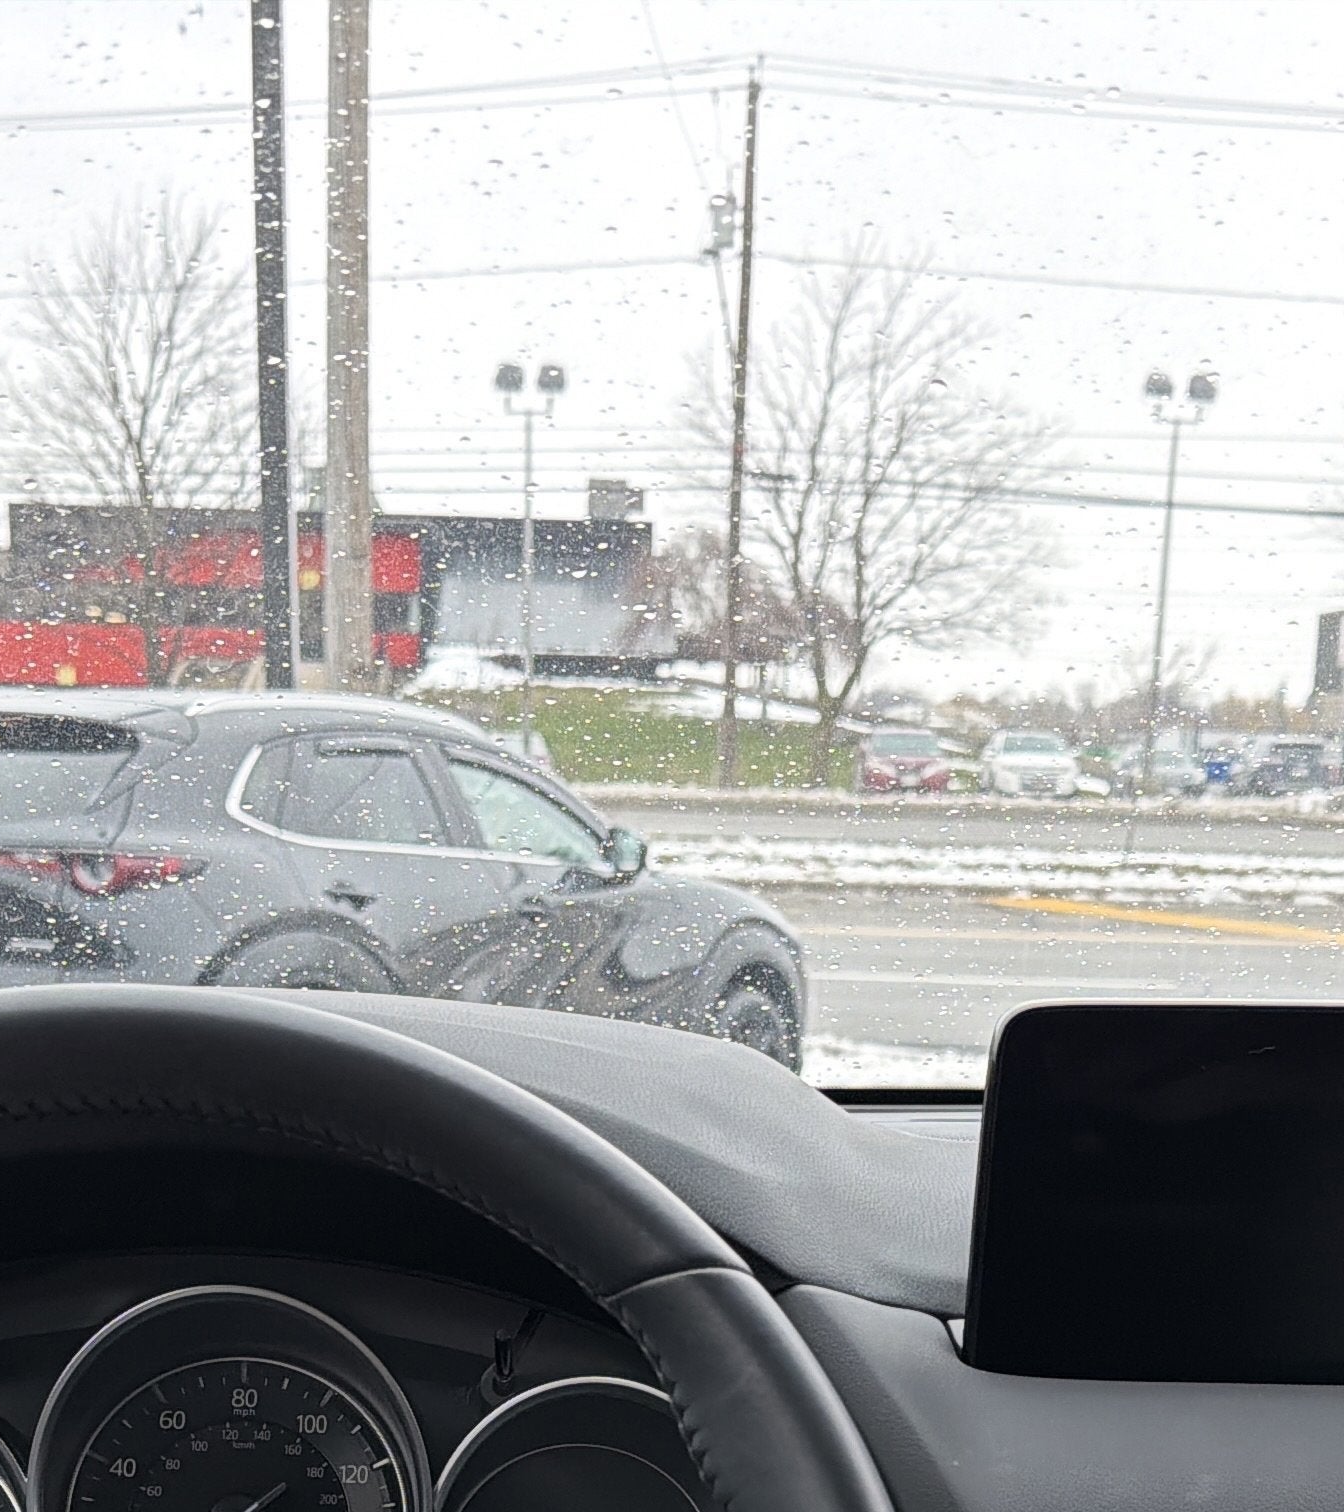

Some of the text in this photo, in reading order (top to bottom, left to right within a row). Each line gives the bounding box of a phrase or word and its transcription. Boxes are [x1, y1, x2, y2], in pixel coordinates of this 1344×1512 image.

[232, 1388, 258, 1408] 80
[233, 1408, 256, 1417] mph
[159, 1410, 186, 1430] 60
[296, 1414, 328, 1434] 100
[221, 1429, 239, 1441] 120
[253, 1430, 271, 1441] 140
[190, 1440, 209, 1452] 100
[284, 1444, 302, 1456] 160
[109, 1458, 136, 1478] 40
[164, 1459, 181, 1470] 80
[306, 1467, 324, 1478] 180
[339, 1464, 369, 1484] 120
[145, 1486, 163, 1497] 60
[319, 1494, 338, 1506] 200
